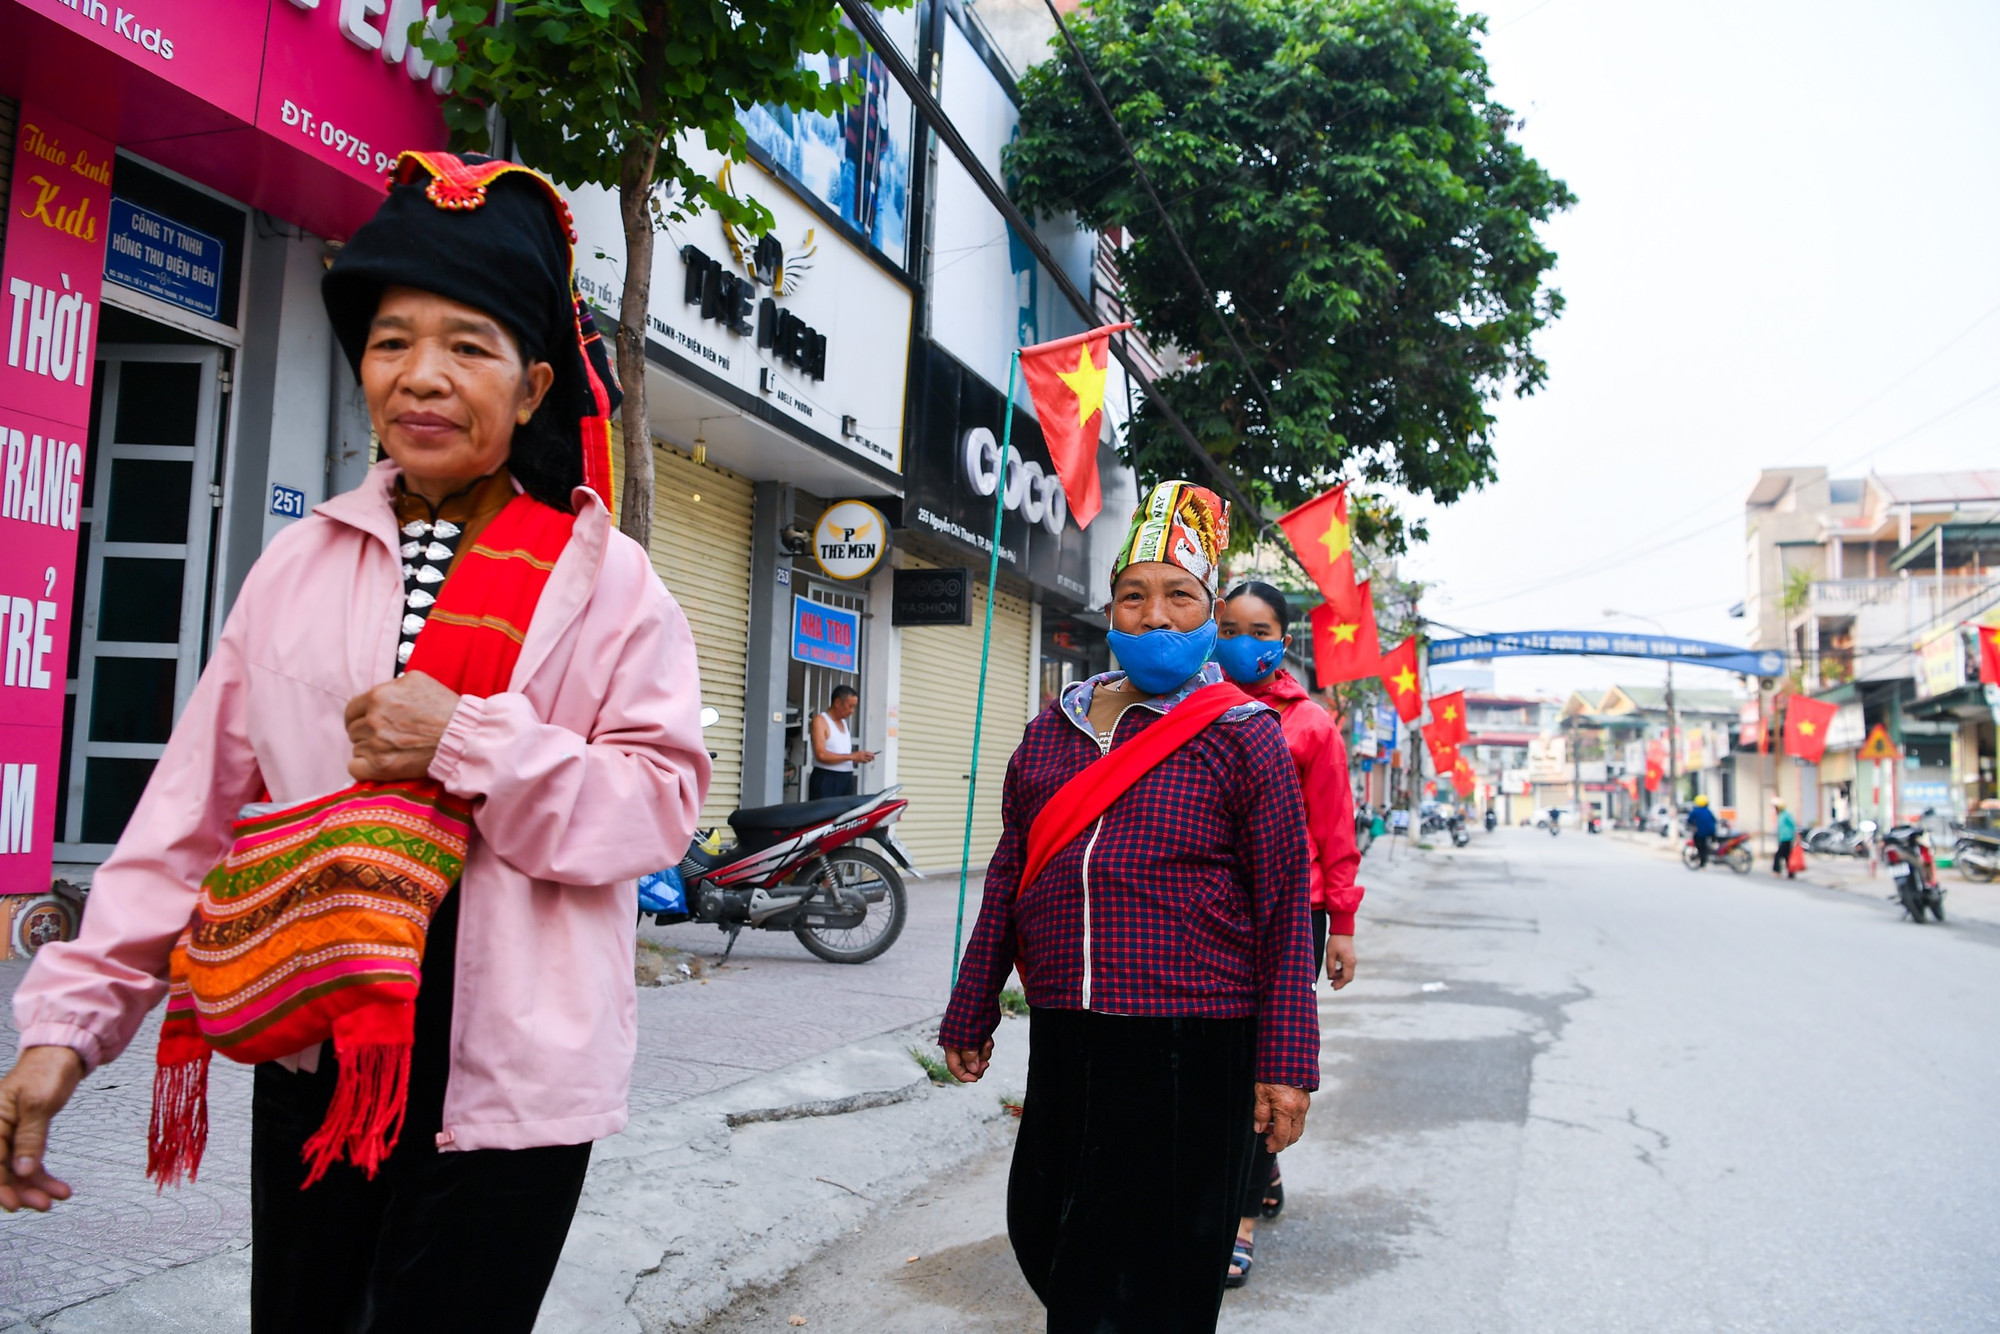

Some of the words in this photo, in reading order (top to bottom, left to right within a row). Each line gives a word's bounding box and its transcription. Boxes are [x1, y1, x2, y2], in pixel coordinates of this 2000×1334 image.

[114, 7, 174, 60] Kids
[281, 98, 316, 137] ĐT:
[320, 121, 370, 166] 0975
[20, 175, 98, 243] Kids
[131, 213, 160, 239] CÔNG
[163, 226, 175, 245] TY
[177, 232, 203, 256] TNHH
[144, 246, 164, 267] THU
[166, 255, 190, 279] ĐIỆN
[192, 266, 215, 288] BIÊN
[8, 273, 92, 387] THỜI
[680, 244, 755, 337] THE
[757, 297, 827, 382] MEN
[273, 490, 302, 514] 251
[963, 427, 1067, 536] COCO
[821, 544, 846, 559] THE
[847, 544, 876, 559] MEN
[843, 528, 855, 542] P
[777, 568, 789, 584] 253
[900, 602, 957, 614] FASHION
[801, 611, 823, 641] NHÀ
[826, 618, 851, 651] TRỌ
